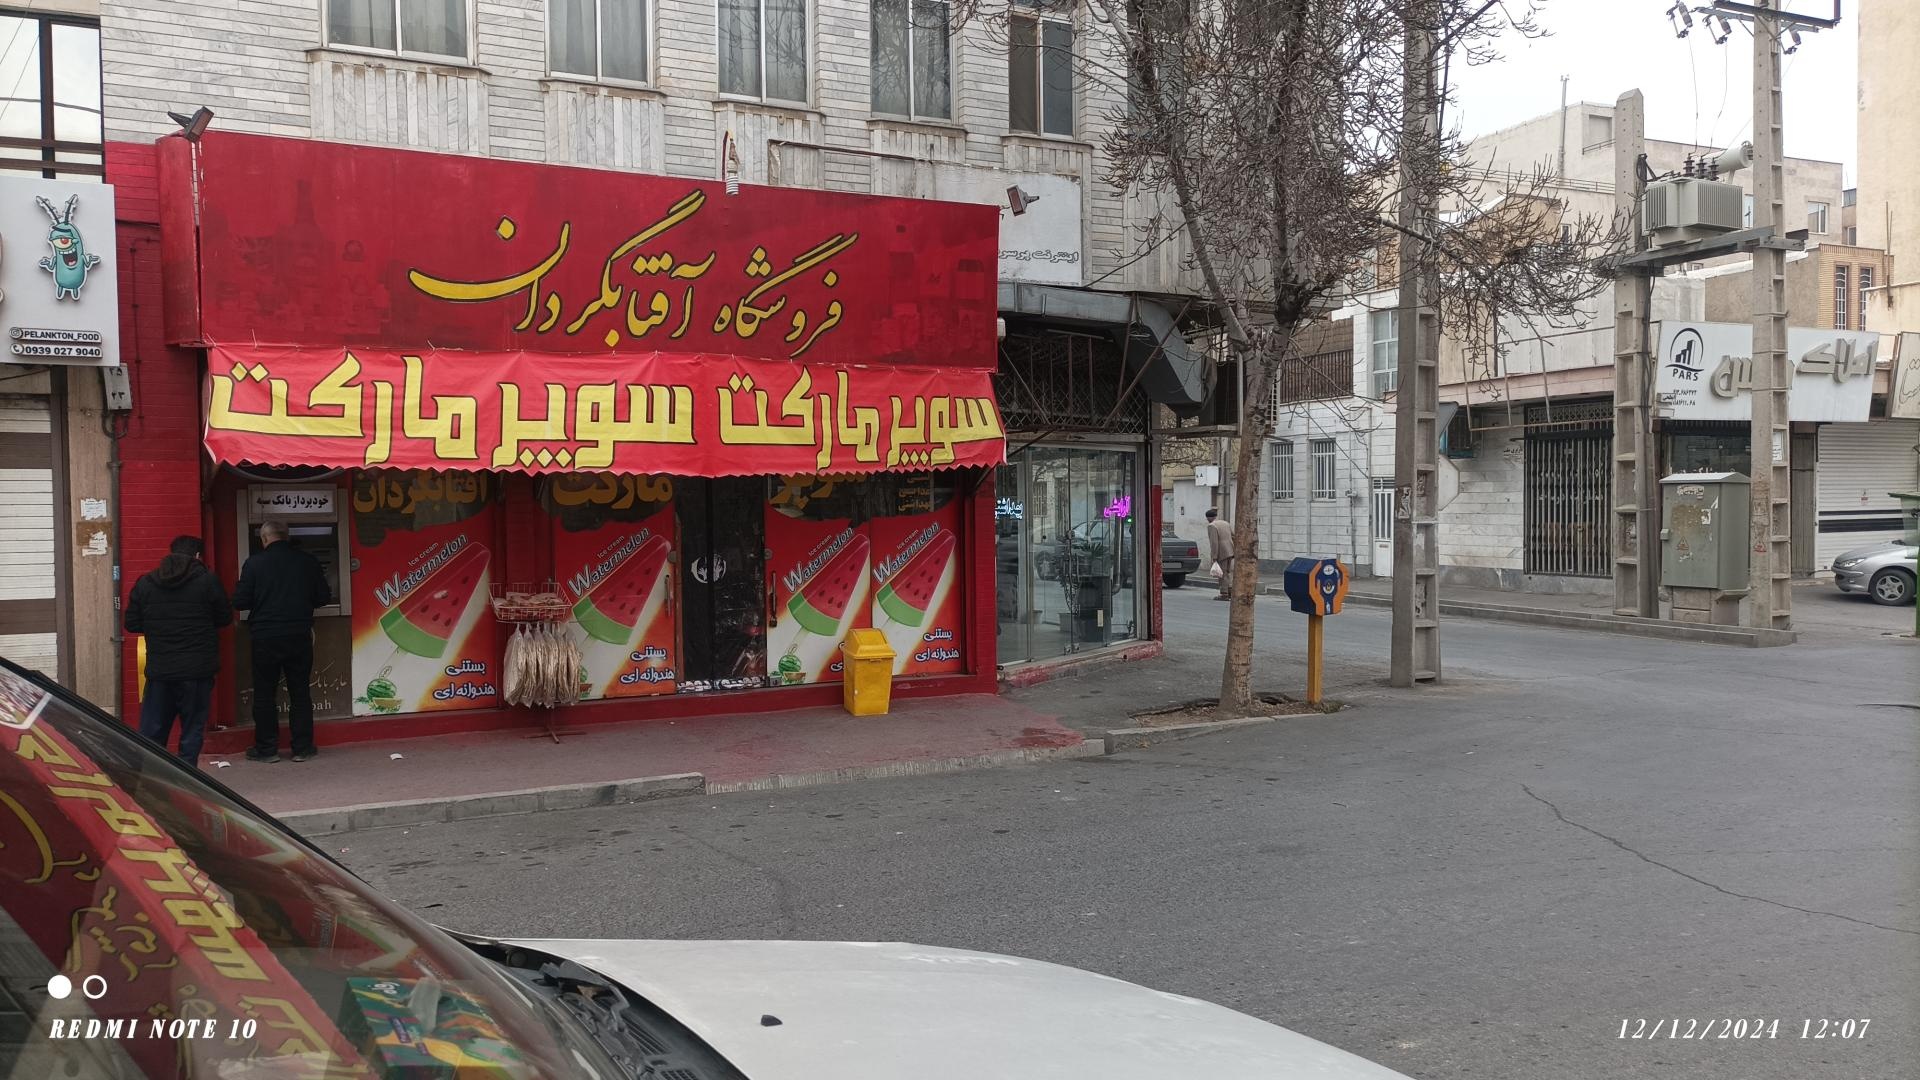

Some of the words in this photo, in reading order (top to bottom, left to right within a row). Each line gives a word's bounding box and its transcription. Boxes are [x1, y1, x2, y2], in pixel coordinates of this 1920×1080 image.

[1032, 249, 1079, 263] اینترنت
[712, 231, 859, 357] فروشگاه
[24, 329, 99, 341] PELANKTON_FOOD
[25, 345, 51, 355] 0939
[53, 346, 72, 356] 027
[75, 347, 101, 357] 9040
[1796, 337, 1879, 384] املاک
[1673, 368, 1698, 381] PARS
[208, 352, 479, 466] مارکت
[717, 364, 880, 470] مارکت
[492, 380, 695, 470] سوپر
[886, 393, 1003, 468] سوپر
[271, 494, 292, 507] بانک
[292, 495, 329, 508] خودپرداز
[607, 535, 625, 552] cream
[816, 533, 832, 549] cream
[904, 530, 919, 546] cream
[419, 542, 439, 559] cream
[873, 522, 940, 584] Watermelon
[567, 527, 650, 598] Watermelon
[783, 526, 855, 593] Watermelon
[374, 533, 469, 608] Watermelon
[923, 628, 953, 641] بستنی
[630, 645, 667, 661] بستنی
[930, 647, 960, 661] هندوانه
[445, 659, 486, 676] بستنی
[640, 667, 675, 683] هندوانه
[455, 681, 496, 700] هندوانه
